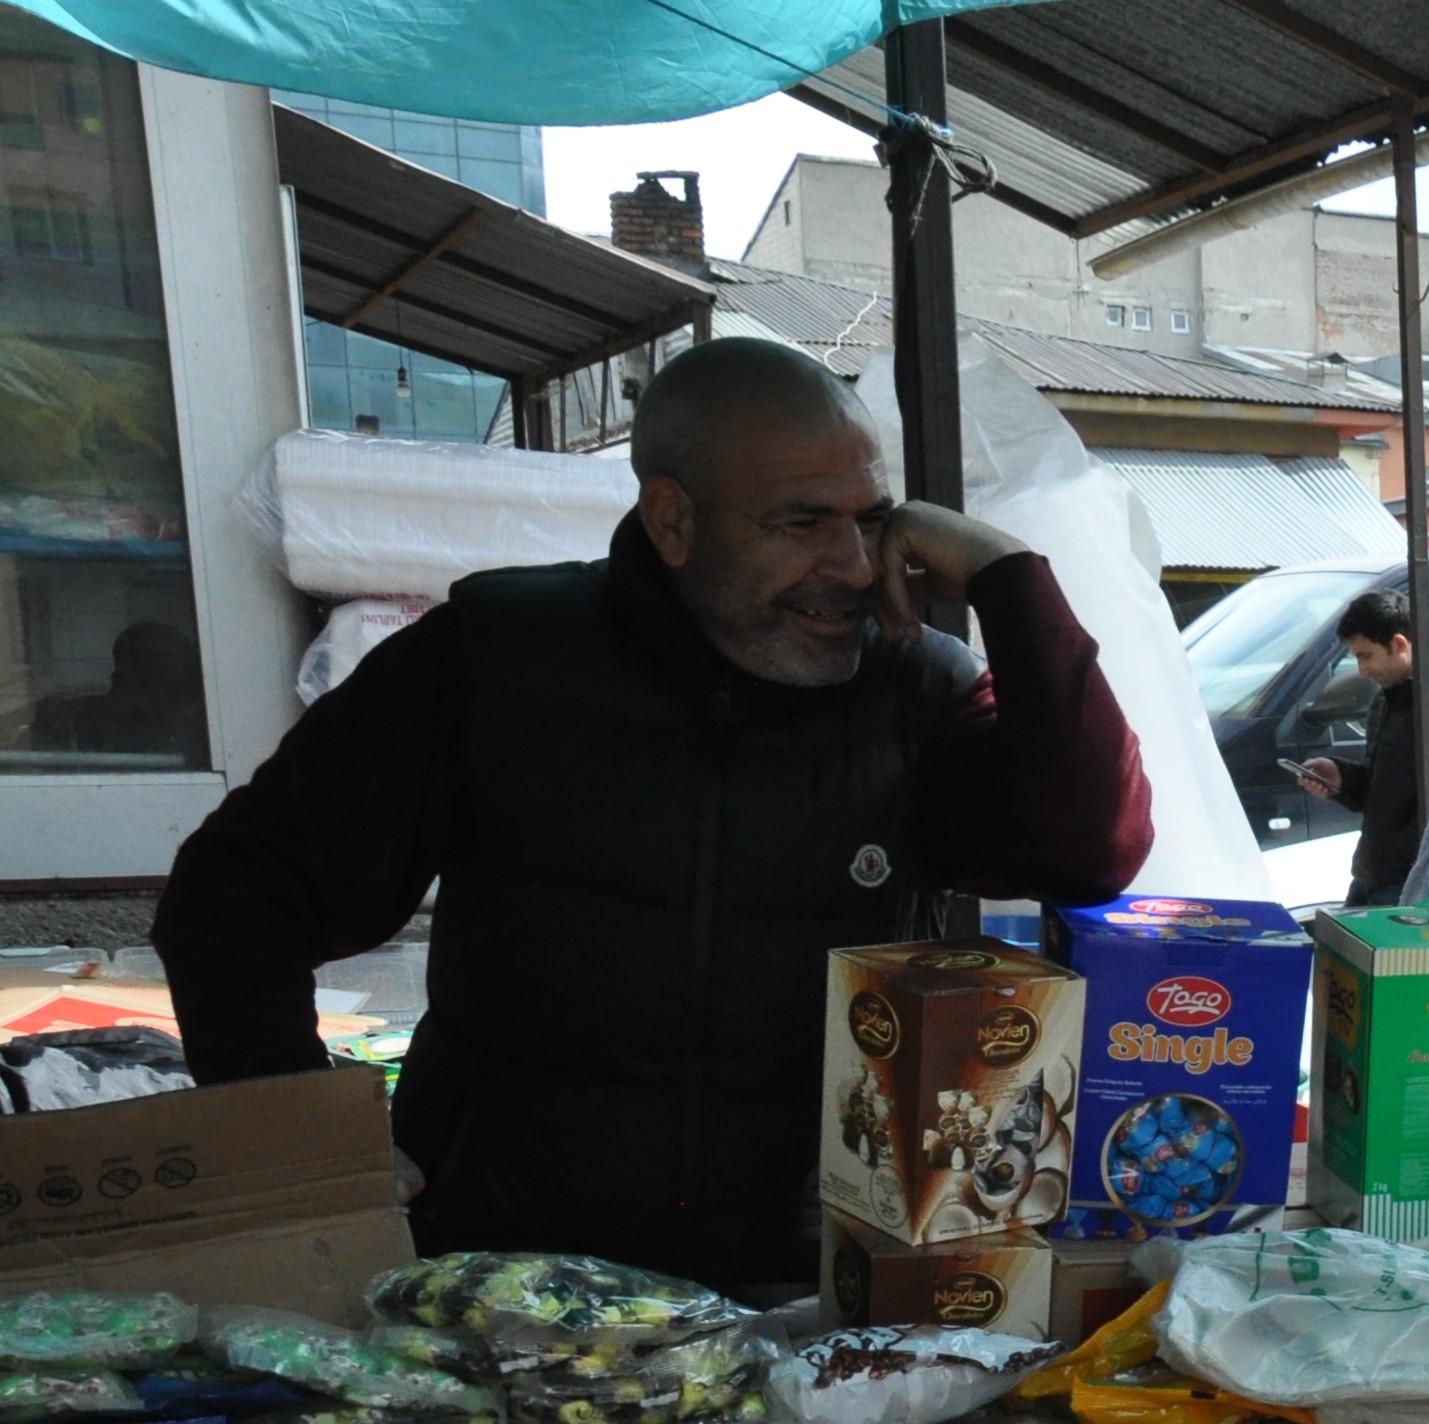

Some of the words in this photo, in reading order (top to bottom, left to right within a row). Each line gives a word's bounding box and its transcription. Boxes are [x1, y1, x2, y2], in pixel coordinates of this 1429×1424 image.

[1157, 982, 1223, 1015] Togo
[1107, 1021, 1254, 1075] Single
[933, 1289, 995, 1312] Novien
